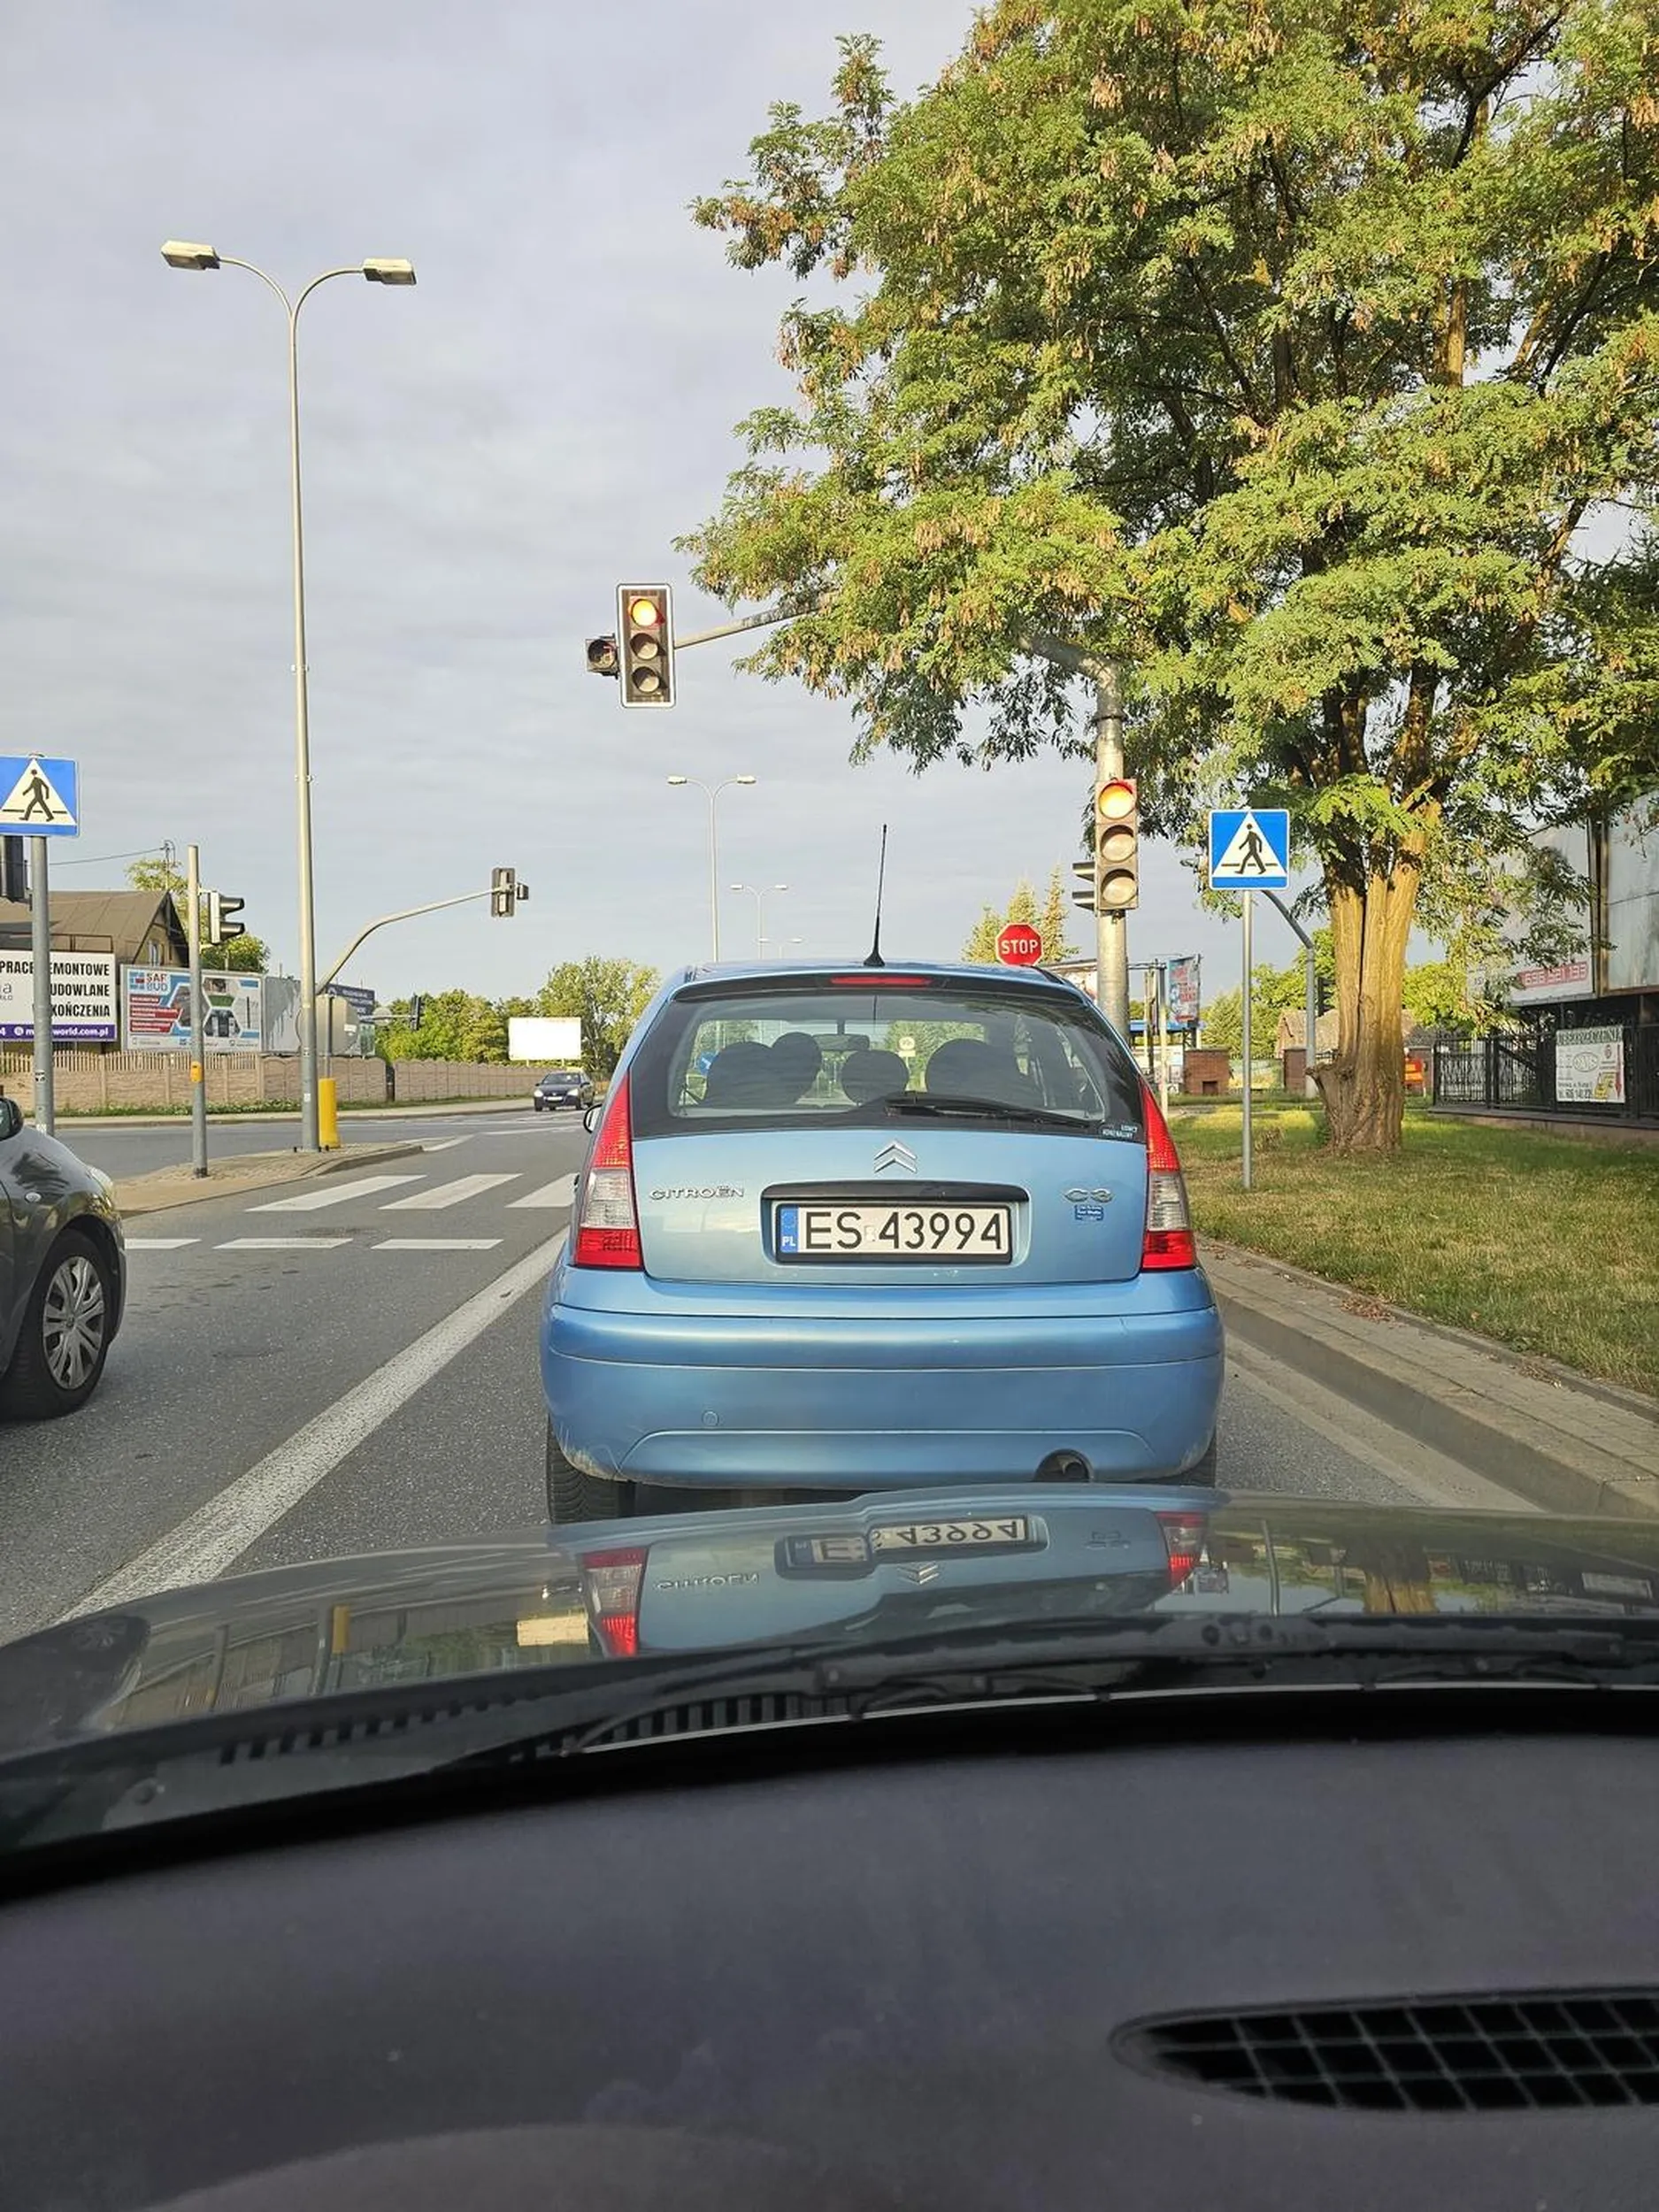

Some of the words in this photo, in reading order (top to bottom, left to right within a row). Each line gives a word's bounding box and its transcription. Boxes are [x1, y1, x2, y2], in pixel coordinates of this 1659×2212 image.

[1001, 939, 1038, 955] STOP
[50, 962, 110, 976] EMONTOWE
[50, 983, 110, 996] UDOWLANE
[51, 1001, 111, 1017] KOŃCZENIA
[26, 1026, 109, 1037] mworld.com.pl
[649, 1185, 744, 1201] CITROËN
[805, 1211, 862, 1249] ES
[879, 1211, 1002, 1249] 43994
[781, 1237, 796, 1247] PL
